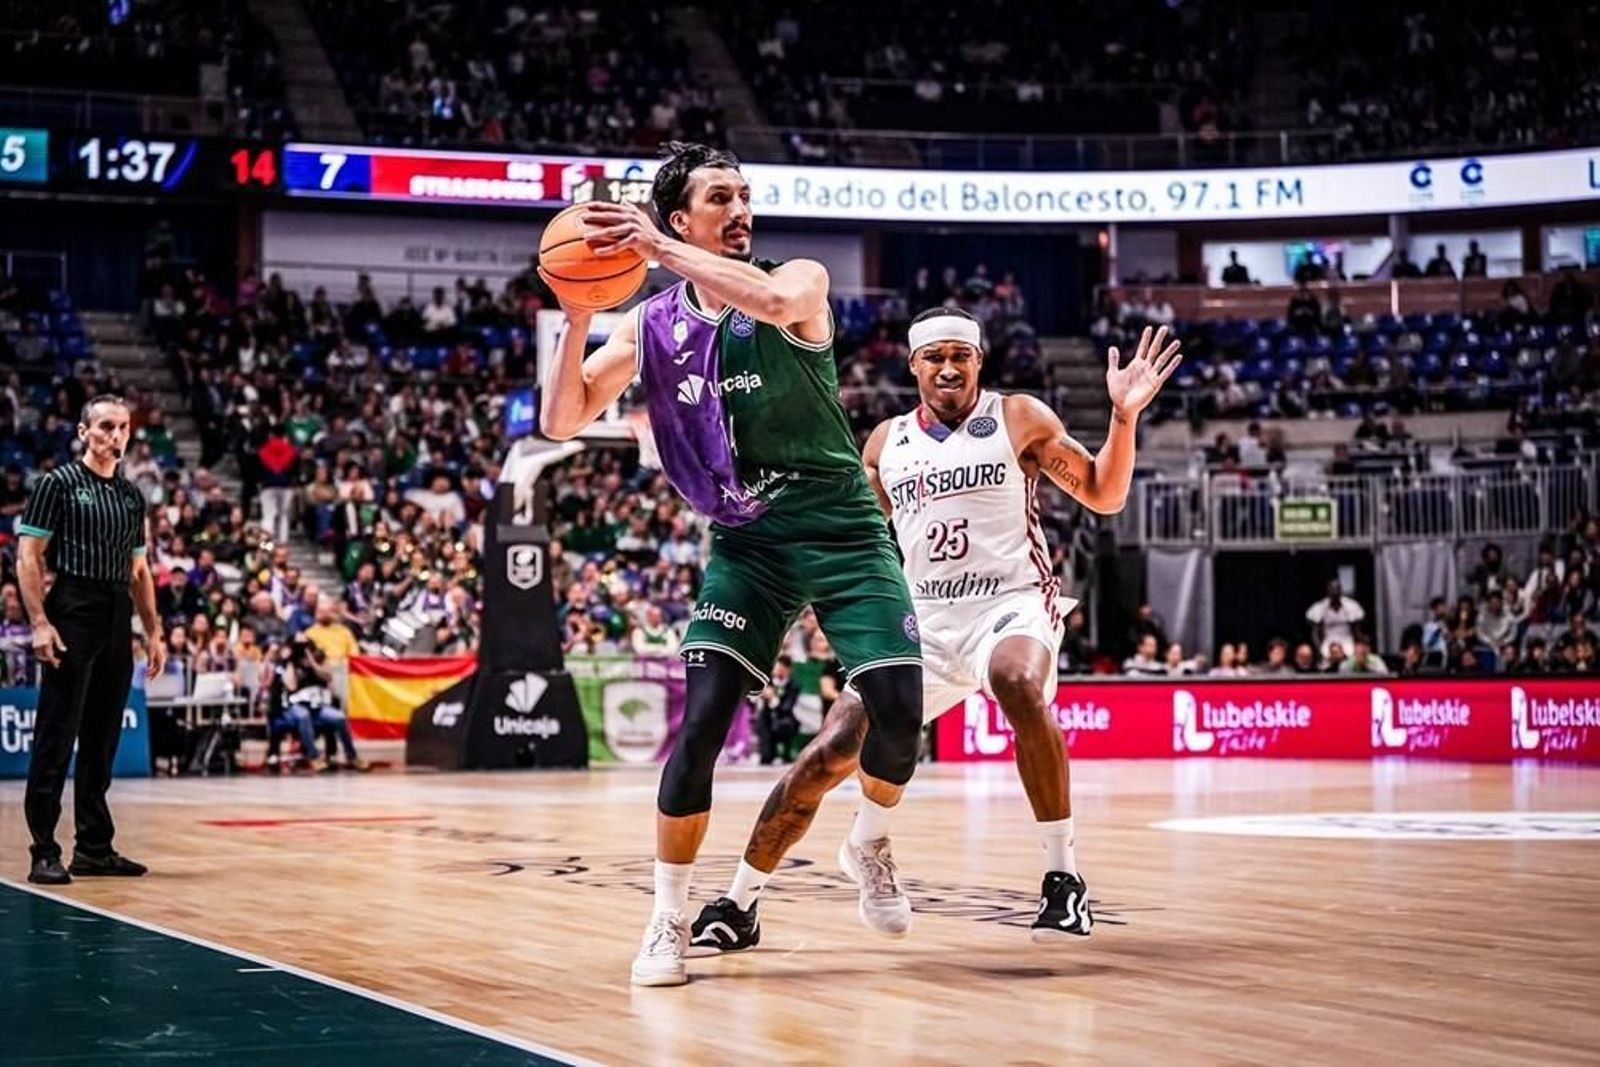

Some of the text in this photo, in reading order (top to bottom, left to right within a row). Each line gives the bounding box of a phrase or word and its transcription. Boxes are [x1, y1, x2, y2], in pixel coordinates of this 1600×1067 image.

[1, 135, 26, 172] 5
[79, 139, 176, 182] 1:37
[231, 149, 275, 185] 14
[319, 153, 346, 189] 7
[793, 177, 884, 209] Radio
[897, 183, 948, 211] del
[960, 183, 1157, 214] Baloncesto,
[1166, 180, 1241, 211] 97.1
[1256, 178, 1303, 207] FM
[891, 462, 1007, 512] STRASBOURG
[926, 518, 969, 563] 25
[493, 715, 560, 739] Unicaja
[1202, 700, 1311, 729] lubelskie
[1398, 698, 1470, 726] lubelskie
